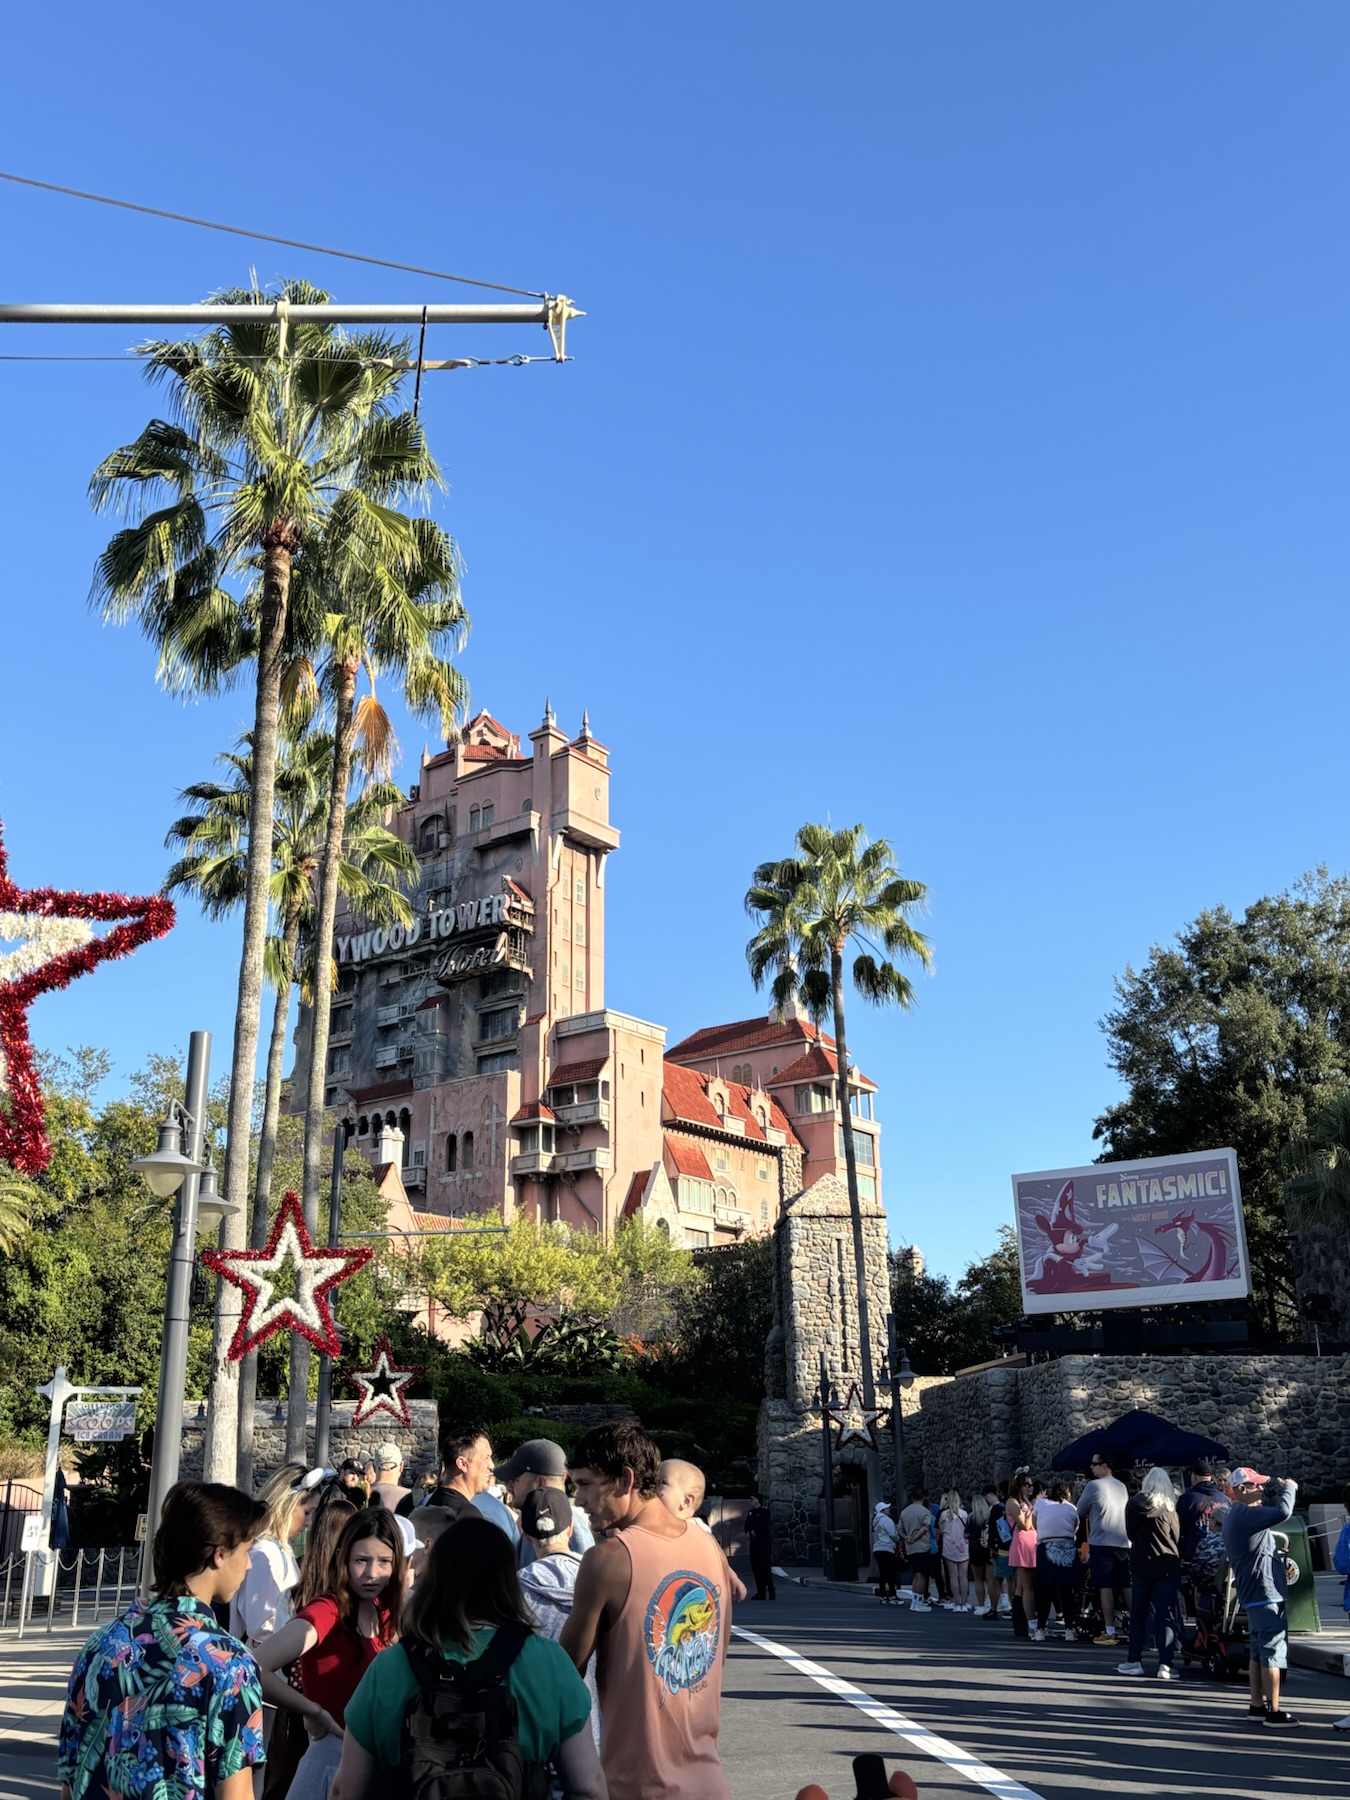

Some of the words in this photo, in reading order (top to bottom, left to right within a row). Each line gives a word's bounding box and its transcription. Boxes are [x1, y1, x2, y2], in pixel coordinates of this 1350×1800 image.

[337, 918, 421, 963] YWOOD
[428, 893, 511, 939] TOWER
[431, 931, 508, 980] Hotel
[1119, 1172, 1139, 1181] Disney
[1096, 1170, 1227, 1209] FANTASMIC!
[1131, 1212, 1150, 1222] MICKEY
[1151, 1210, 1169, 1220] MOUSE
[66, 1416, 134, 1431] SCOOPS
[77, 1431, 90, 1439] ICE
[92, 1431, 122, 1439] CREAM
